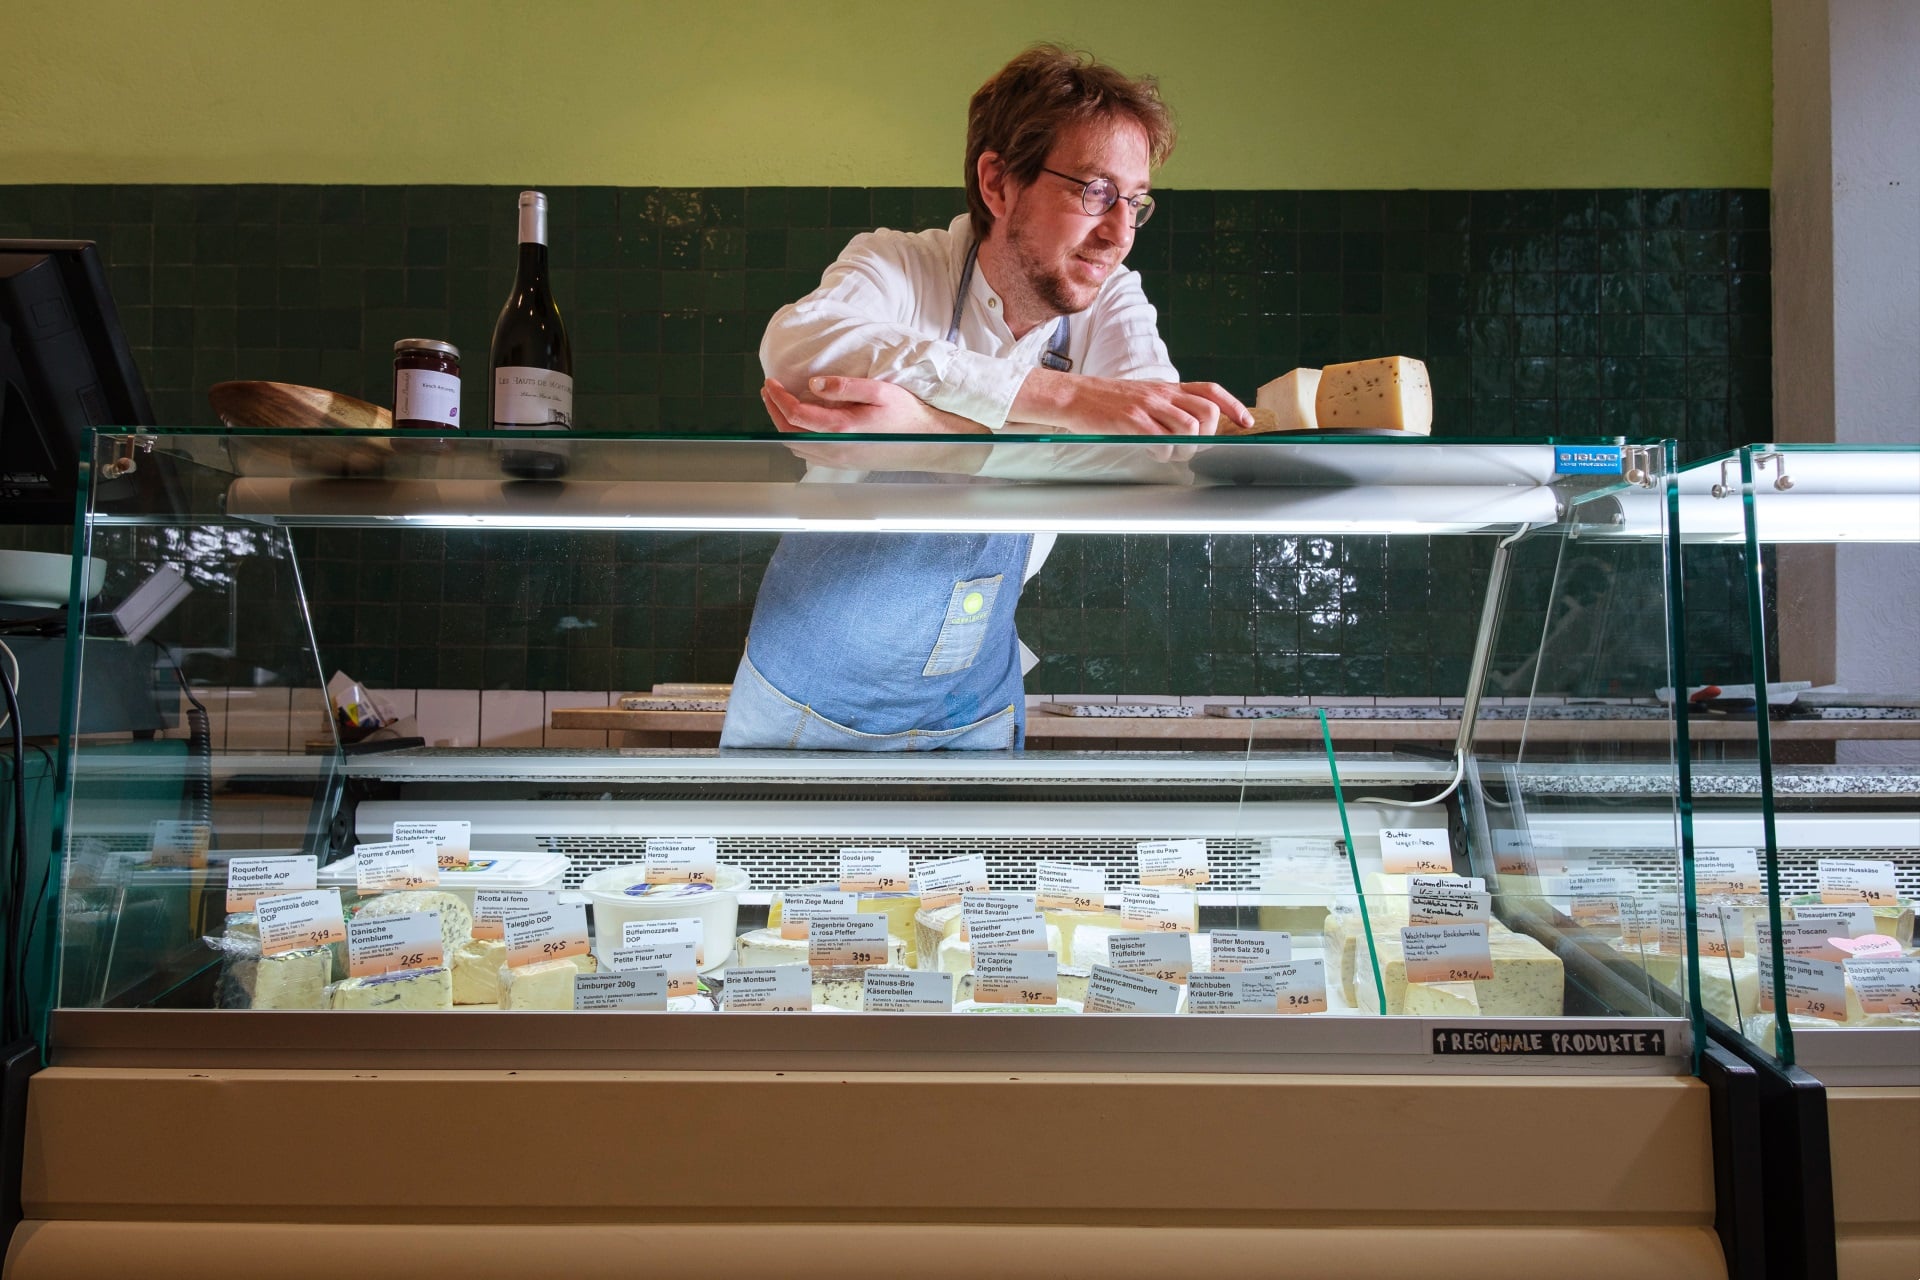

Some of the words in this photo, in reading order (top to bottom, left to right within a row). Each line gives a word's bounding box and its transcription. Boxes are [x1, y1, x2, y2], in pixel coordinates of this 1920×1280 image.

[1574, 453, 1618, 462] IGLOO
[1385, 830, 1412, 838] Butter
[861, 854, 874, 862] jung
[232, 866, 268, 874] Roquefort
[918, 869, 936, 877] Fontal
[232, 874, 272, 882] Roquebelle
[1413, 878, 1472, 889] Kümmellümmel
[804, 898, 822, 906] Ziege
[1123, 897, 1156, 905] Ziegenrolle
[259, 903, 300, 915] Gorgonzola
[300, 899, 319, 908] dolce
[986, 902, 1019, 910] Bourgogne
[260, 914, 277, 923] DOP
[506, 920, 536, 929] Taleggio
[536, 916, 552, 924] DOP
[811, 922, 846, 930] Ziegenbrie
[846, 922, 874, 930] Oregano
[351, 926, 387, 936] Dänische
[626, 927, 679, 936] Büffelmozzarella
[352, 934, 394, 944] Kornblume
[1234, 938, 1265, 946] Montsurs
[1110, 942, 1146, 950] Belgischer
[1112, 950, 1146, 958] Trüffelbrie
[614, 956, 634, 964] Petite
[1282, 969, 1297, 977] AOP
[1798, 966, 1812, 976] jung
[577, 982, 616, 990] Limburger
[618, 980, 636, 988] 200g
[867, 979, 915, 987] Walnuss-Brie
[1092, 972, 1158, 995] Bauerncamembert
[1190, 981, 1231, 989] Milchbuben
[866, 988, 913, 996] Käserebellen
[1091, 982, 1115, 994] Jersey
[1190, 990, 1234, 998] Kräuter-Brie
[1551, 1032, 1653, 1052] PRODUKTE
